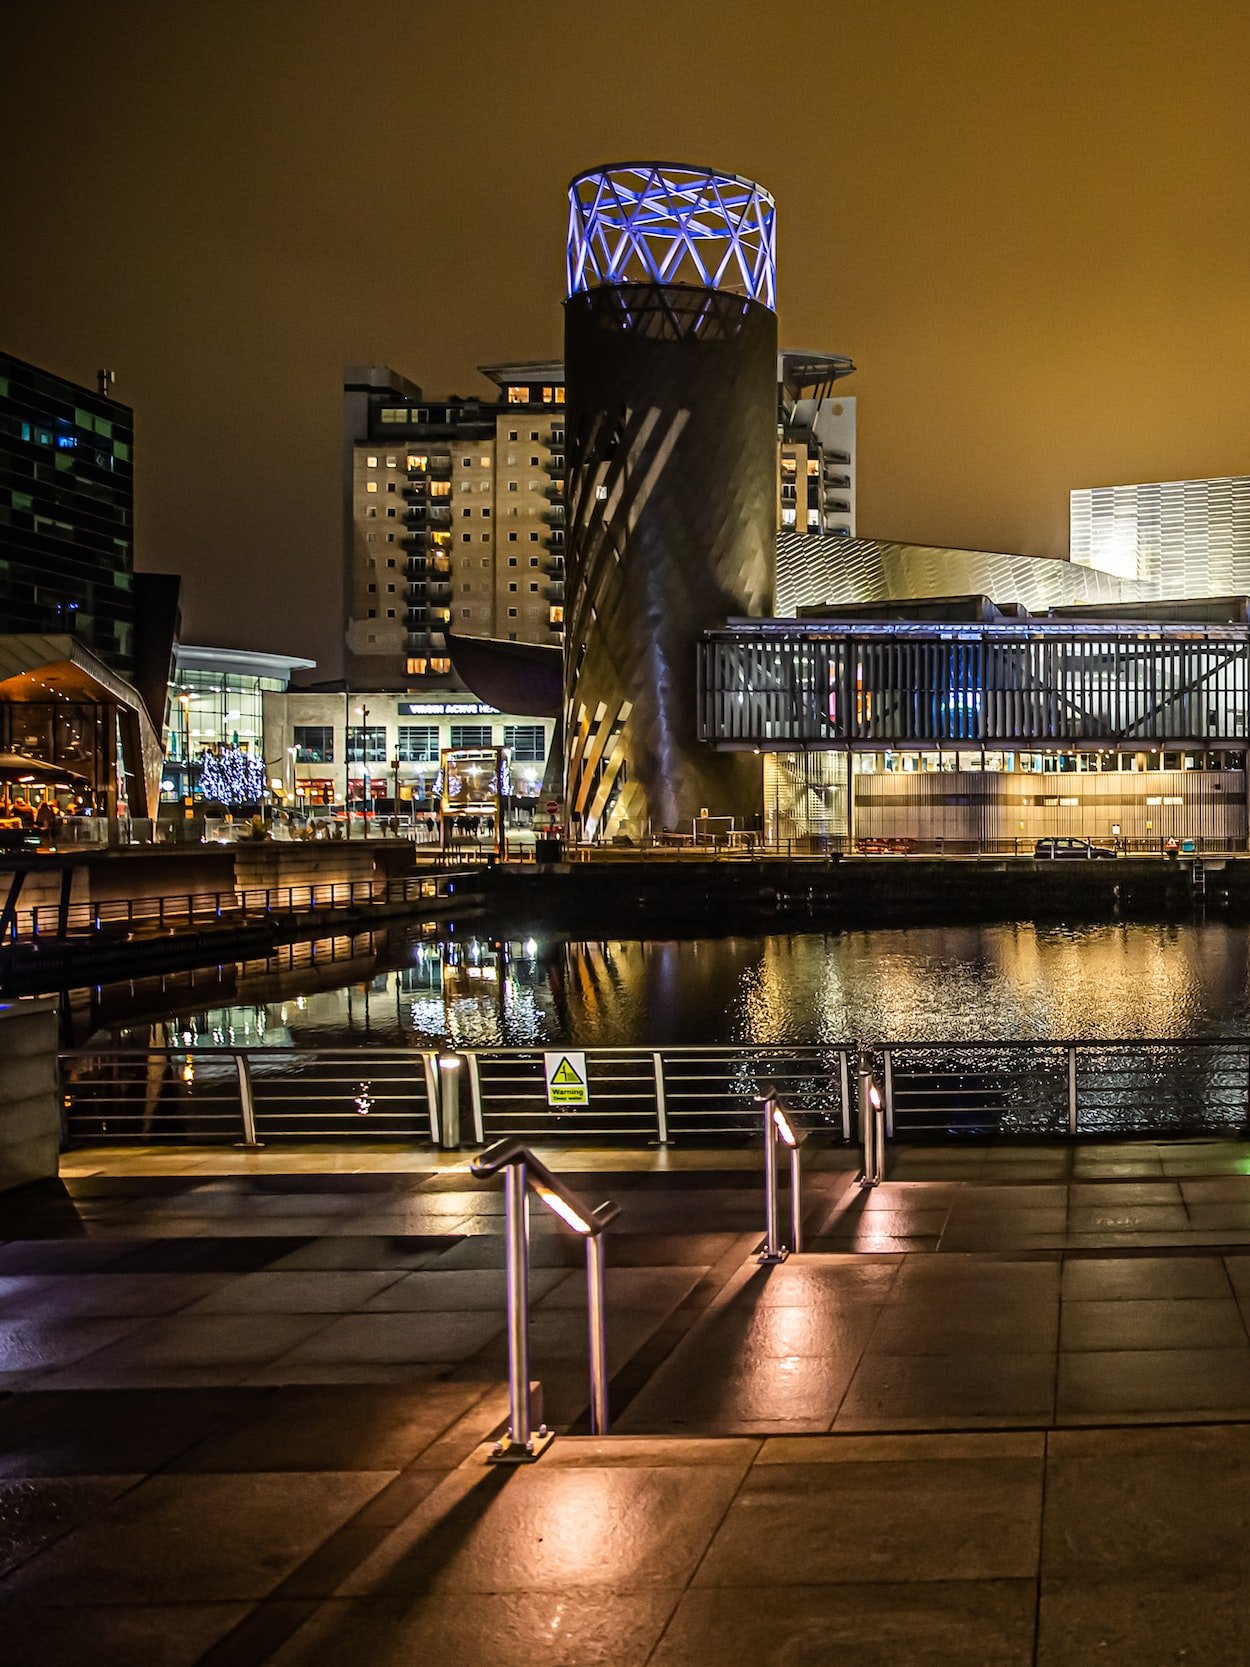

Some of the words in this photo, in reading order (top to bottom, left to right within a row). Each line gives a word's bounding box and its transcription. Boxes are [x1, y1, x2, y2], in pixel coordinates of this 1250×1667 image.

[409, 704, 444, 714] VIRGIN
[445, 704, 478, 714] ACTIVE
[479, 704, 501, 714] HEA
